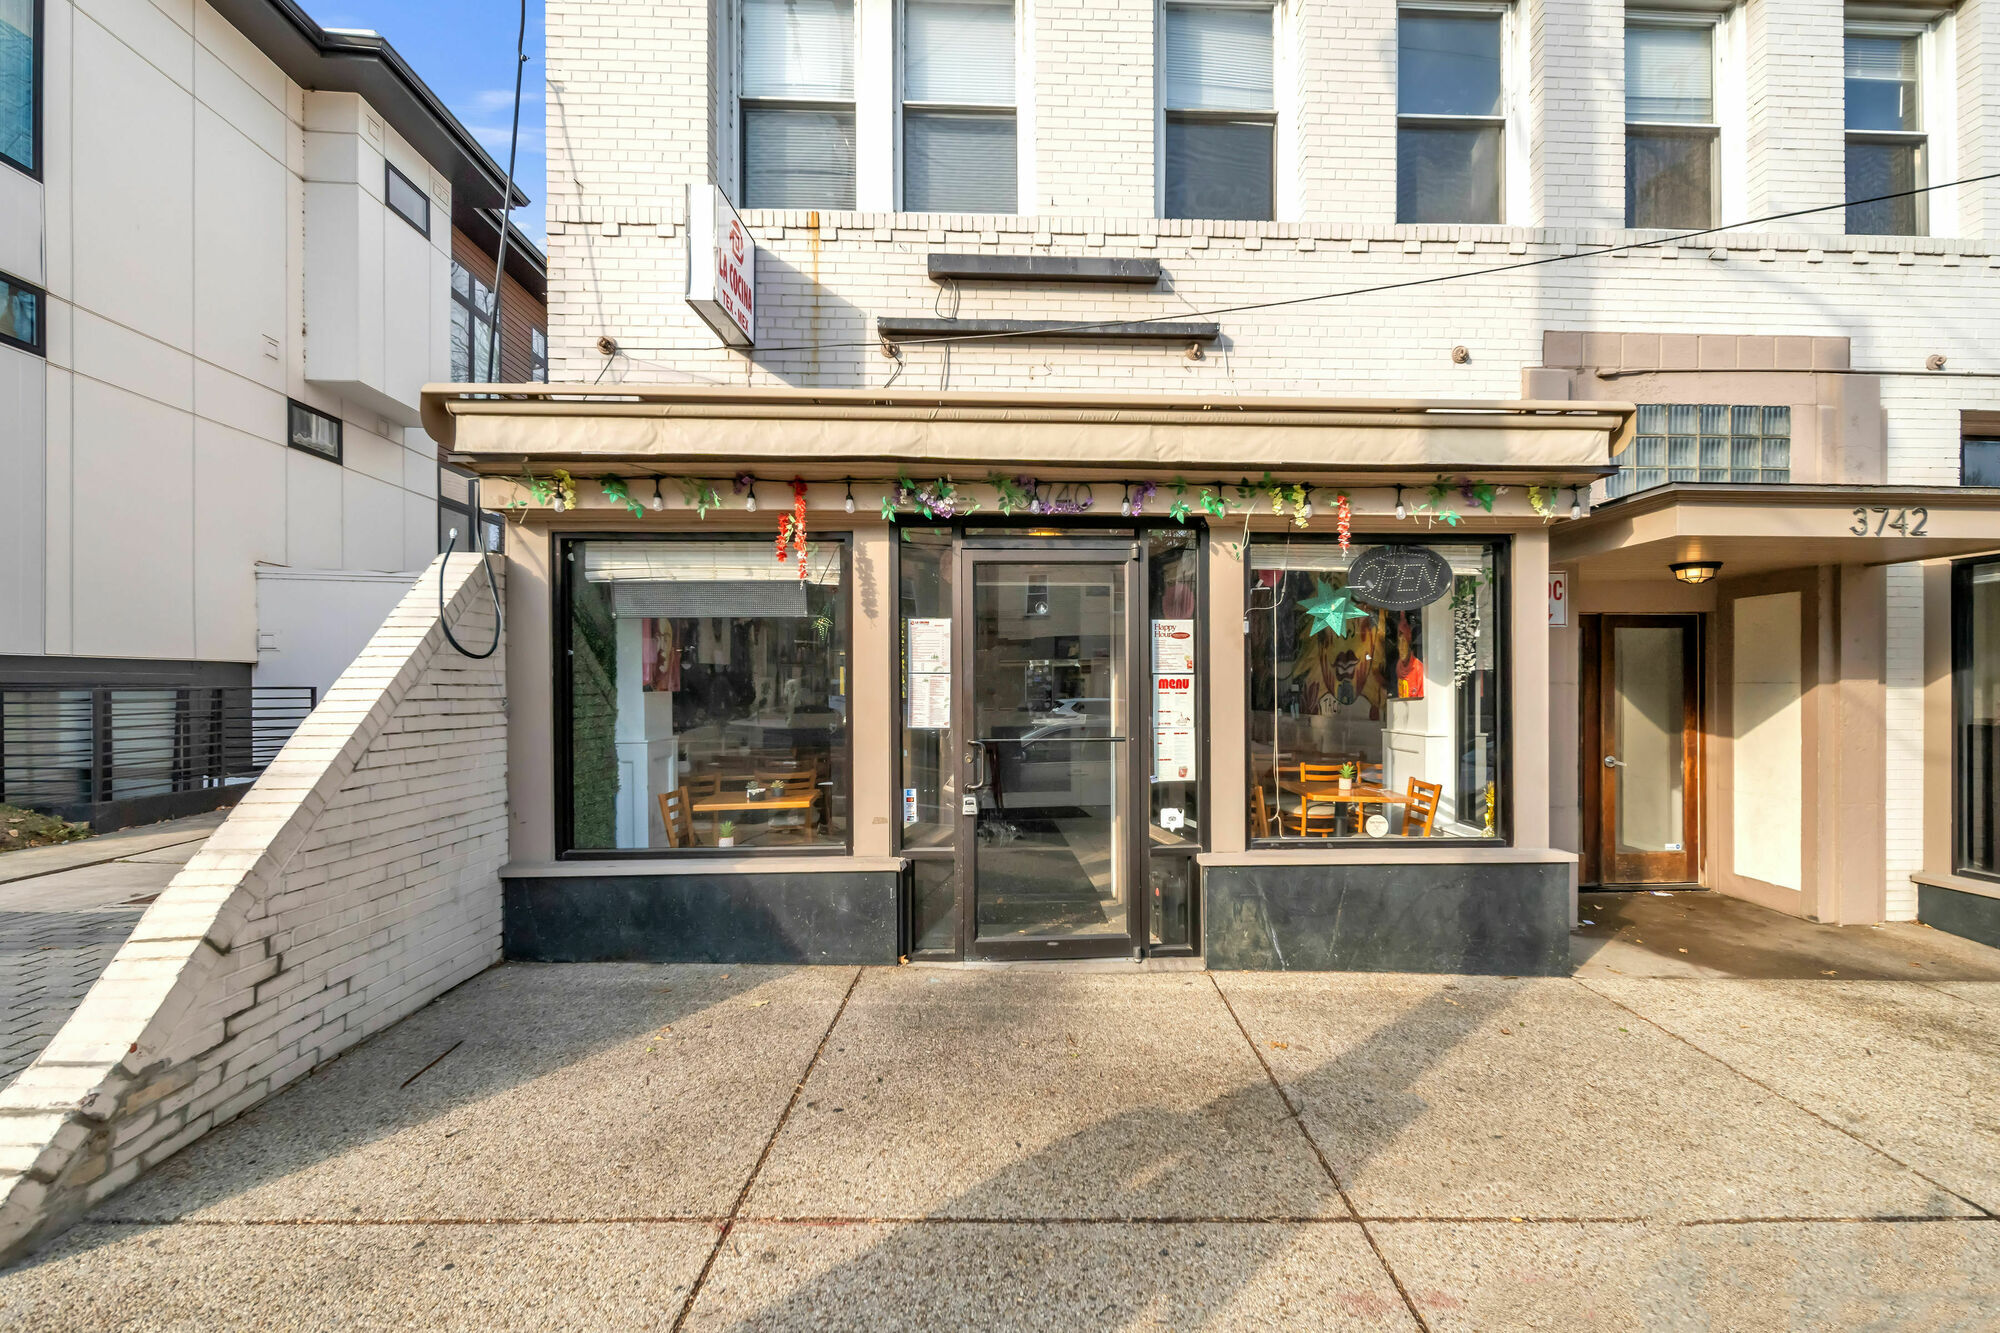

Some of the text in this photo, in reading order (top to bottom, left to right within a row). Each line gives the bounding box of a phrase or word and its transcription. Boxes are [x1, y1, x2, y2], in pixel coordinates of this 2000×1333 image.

[718, 247, 753, 315] LA COCINA
[722, 288, 734, 315] TEX
[737, 308, 749, 333] MEX
[1014, 482, 1093, 512] 740
[1849, 506, 1929, 537] 3742
[1357, 562, 1443, 594] OPEN
[1154, 623, 1177, 632] Happy
